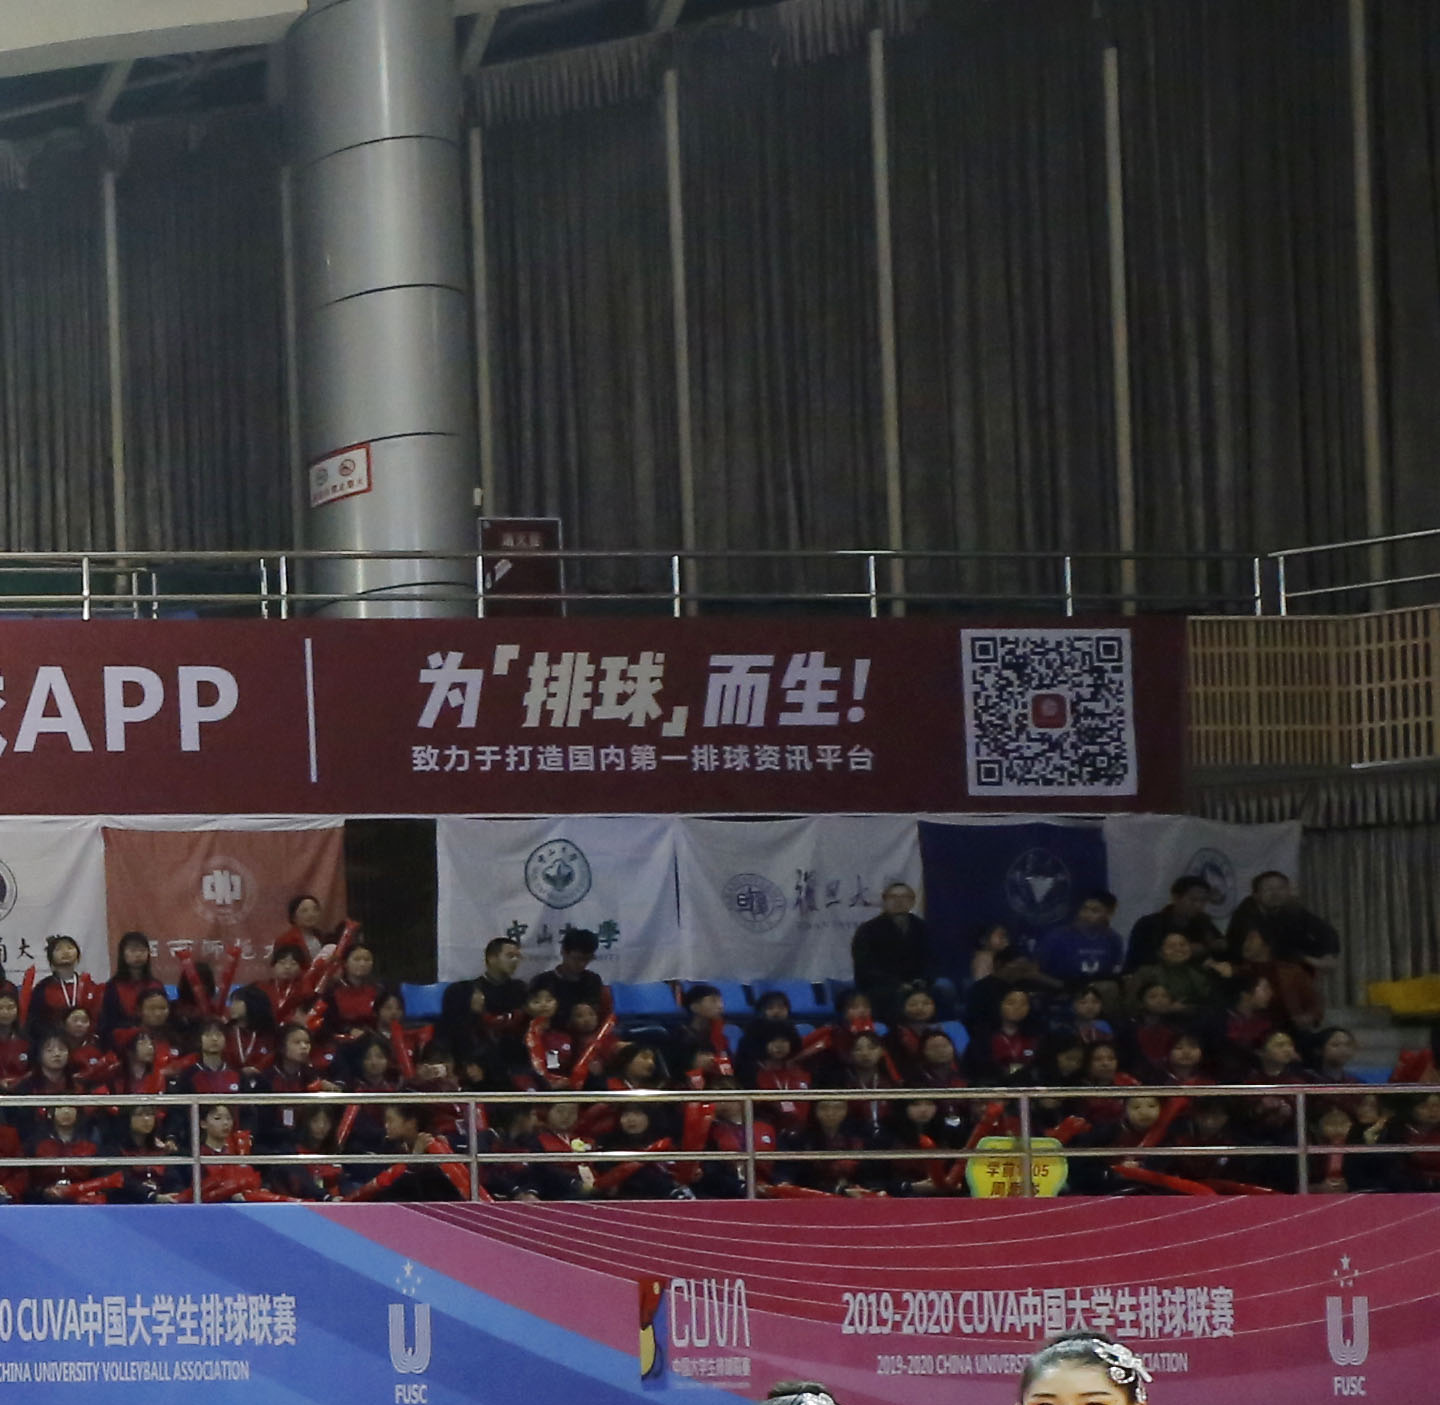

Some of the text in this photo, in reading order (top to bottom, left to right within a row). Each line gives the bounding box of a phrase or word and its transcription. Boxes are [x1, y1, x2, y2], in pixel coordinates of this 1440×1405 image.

[411, 743, 875, 773] 致力于打造国内第一排球资讯平台
[16, 1294, 297, 1348] CUVA中国大学生排球联赛
[670, 1279, 750, 1348] CUVA
[841, 1287, 1234, 1339] 2019-2020 CUVA中国大学生排球联赛
[34, 1361, 99, 1383] UNIVERSITY
[101, 1361, 170, 1382] VOLLEYBALL
[174, 1360, 249, 1382] ASSOCIATION
[876, 1354, 934, 1376] 2019-2020
[936, 1354, 972, 1376] CHINA
[975, 1353, 1030, 1375] UNIVERS
[395, 1385, 428, 1405] FUSC
[1333, 1376, 1366, 1397] FUSC
